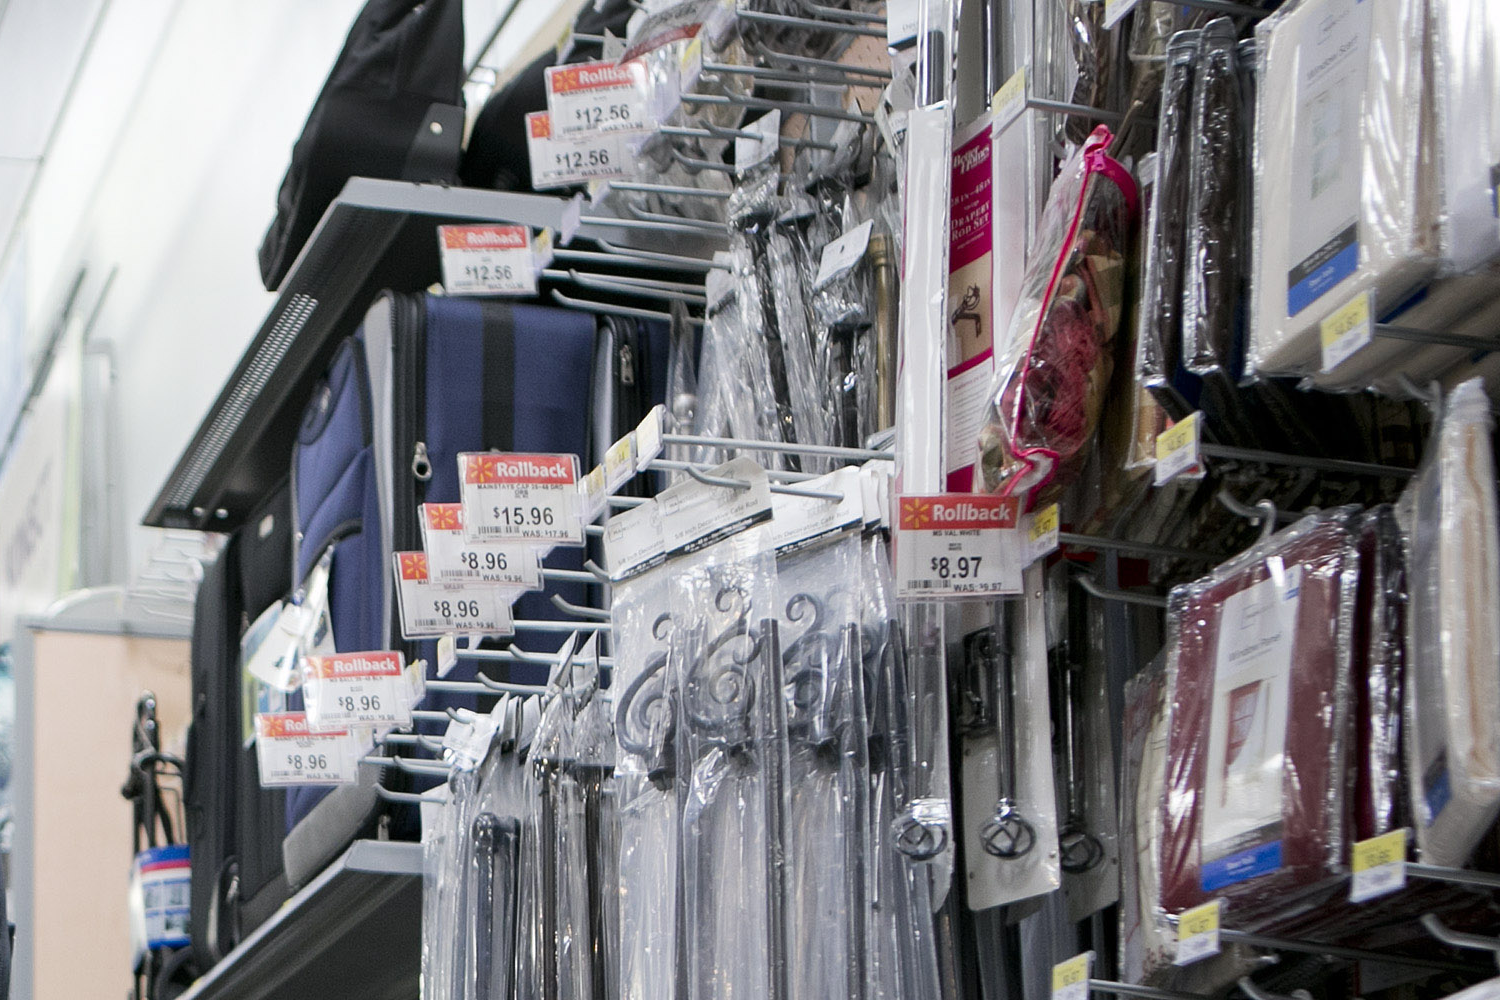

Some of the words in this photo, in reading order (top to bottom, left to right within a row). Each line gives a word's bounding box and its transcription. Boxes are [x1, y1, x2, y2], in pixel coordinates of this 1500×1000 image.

[579, 64, 635, 85] Rollbac
[575, 104, 630, 123] $12.56
[555, 149, 609, 168] $12.56
[465, 265, 513, 280] $12.56
[496, 461, 568, 478] Rollback
[493, 506, 554, 526] $15.96
[932, 503, 1010, 521] Rollback
[522, 530, 542, 538] WAS:
[461, 552, 508, 570] $8.96
[931, 556, 982, 579] $8.97
[483, 574, 501, 582] WAS:
[954, 583, 975, 592] WAS:
[434, 600, 479, 618] $8.96
[456, 621, 473, 629] WAS:
[333, 657, 397, 673] Rollback
[338, 696, 381, 712] $8.96
[287, 755, 328, 769] $8.96
